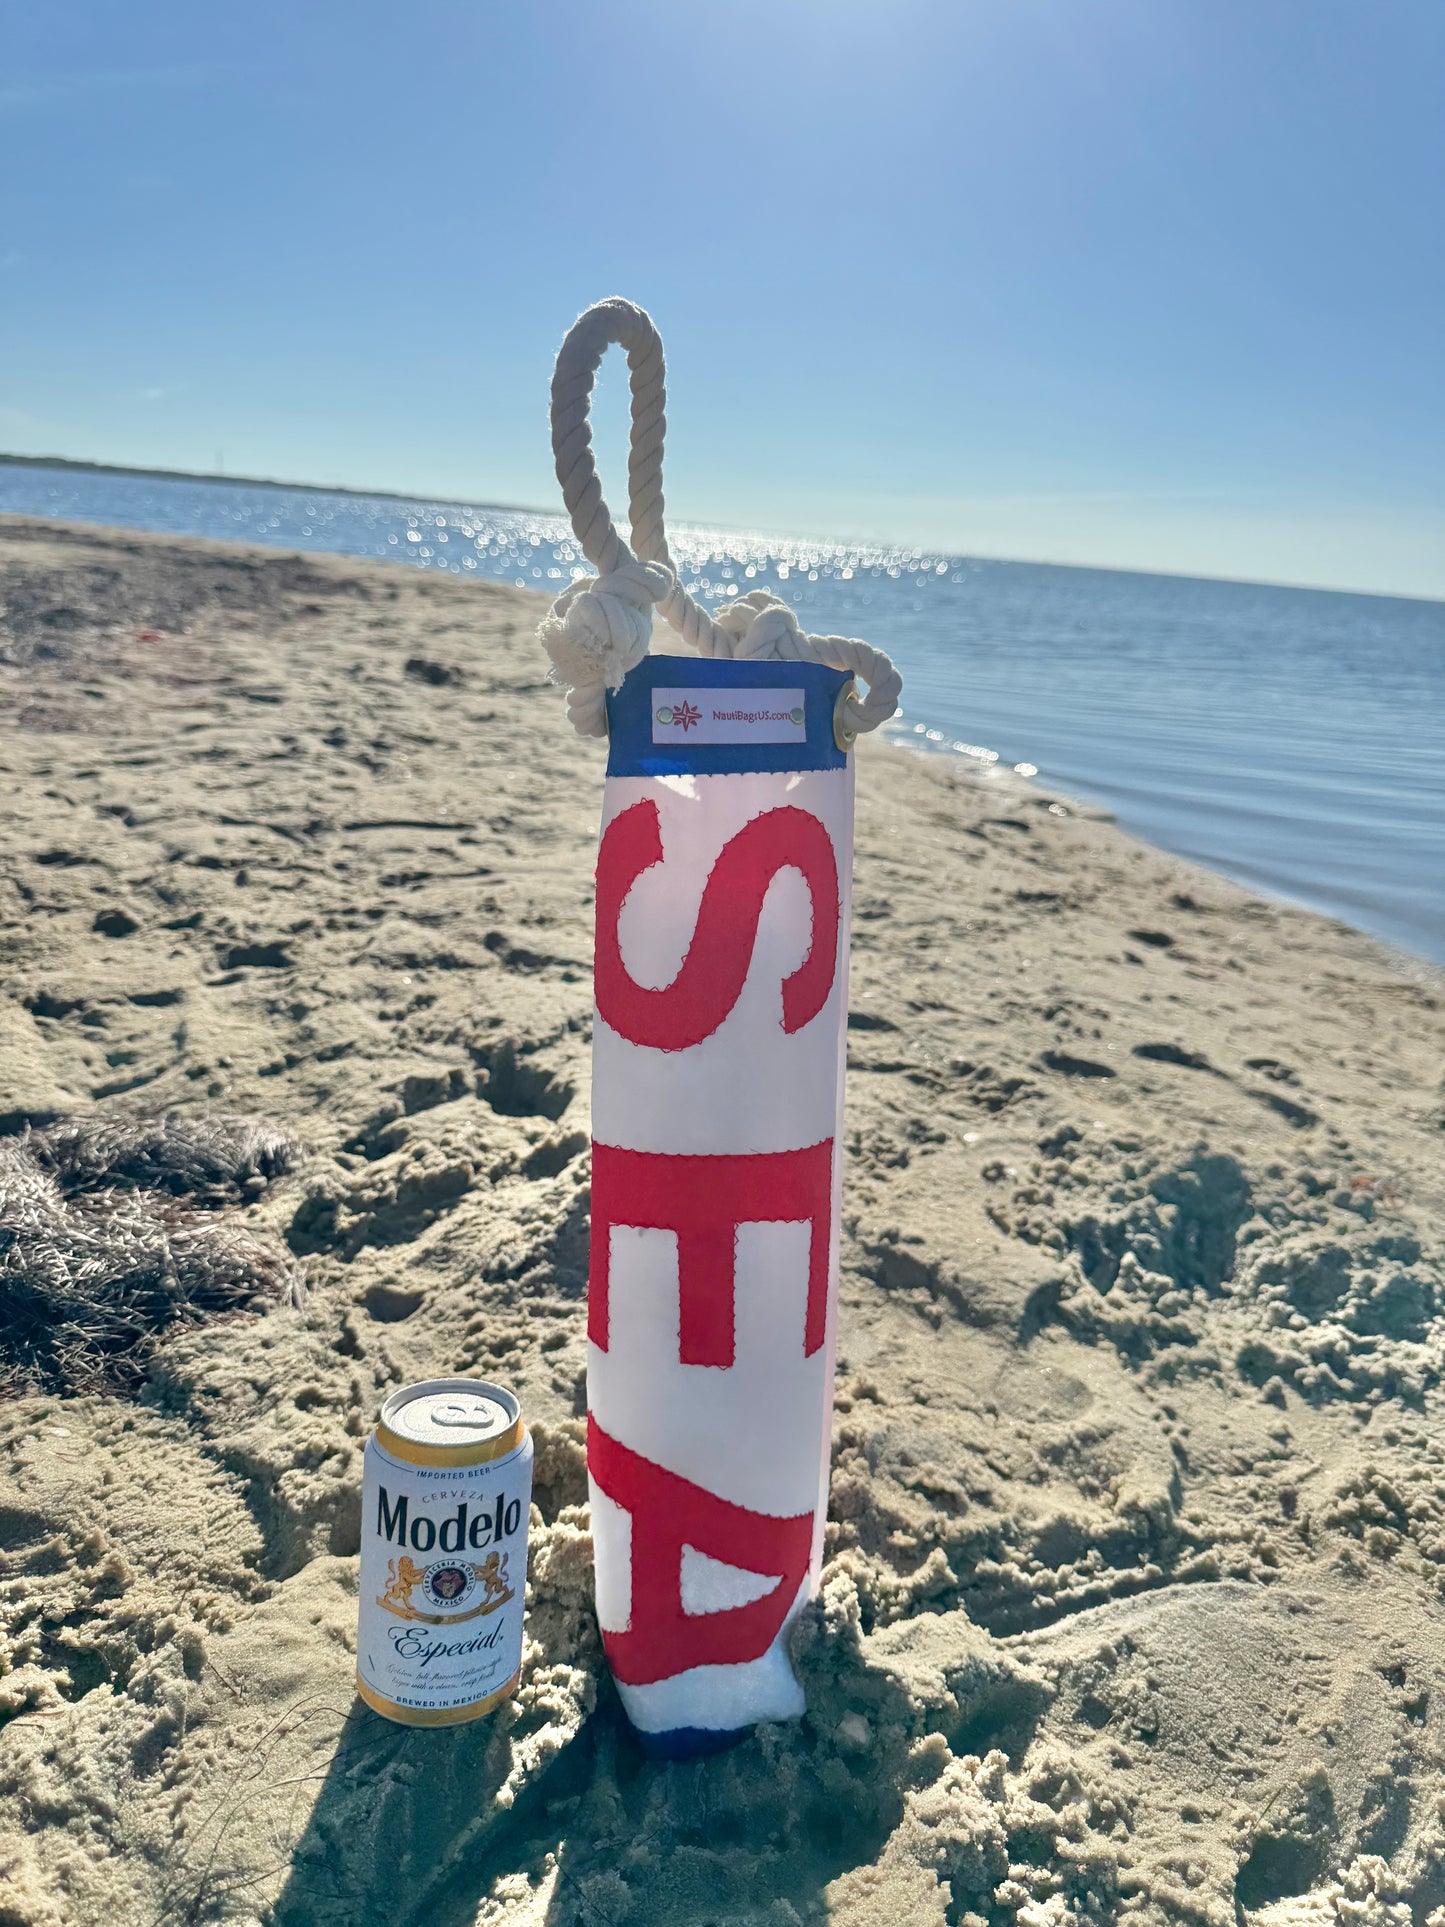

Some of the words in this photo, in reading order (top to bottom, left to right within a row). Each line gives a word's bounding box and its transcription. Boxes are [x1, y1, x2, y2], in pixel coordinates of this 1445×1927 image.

[712, 710, 791, 724] NautiBagsUS.com
[586, 797, 841, 1686] SEA
[416, 1470, 465, 1480] IMPORTED
[468, 1467, 491, 1478] BEER
[422, 1489, 485, 1504] CERVEZA
[377, 1484, 521, 1553] Modelo
[432, 1595, 464, 1606] MEXICO
[396, 1695, 436, 1707] BREWED
[452, 1690, 488, 1706] MEXICO
